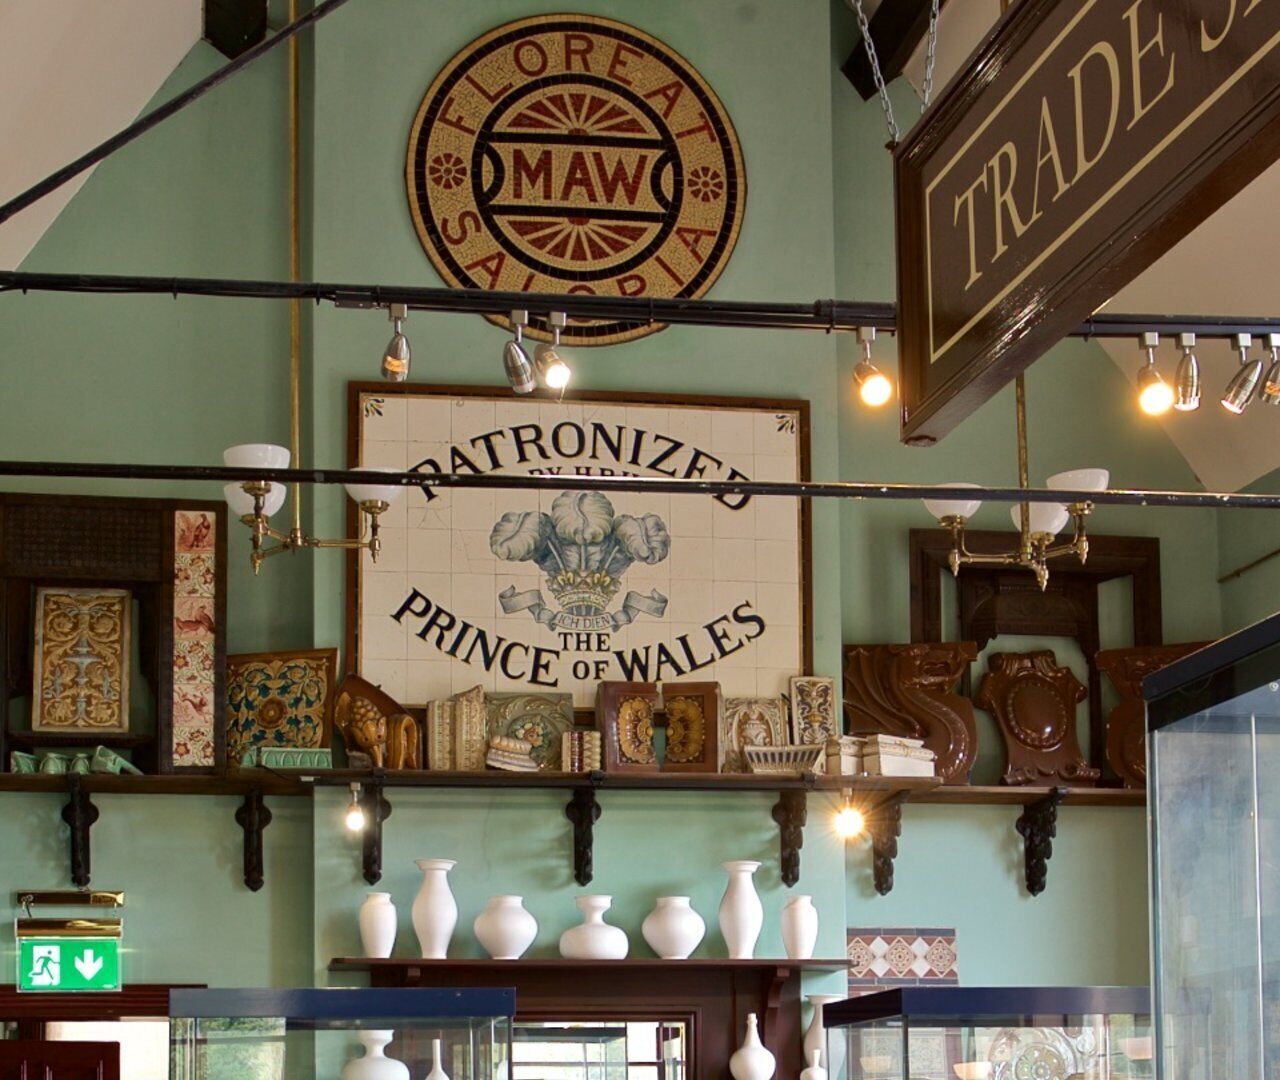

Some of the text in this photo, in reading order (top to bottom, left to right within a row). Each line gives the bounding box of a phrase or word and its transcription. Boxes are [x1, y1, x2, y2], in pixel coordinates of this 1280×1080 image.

[437, 33, 718, 144] FLOREAT
[512, 148, 649, 206] MAW
[953, 0, 1176, 292] TRADE
[441, 210, 718, 300] SAPIA
[407, 421, 753, 511] PATRONIZED
[390, 587, 561, 688] PRINCE
[557, 614, 612, 629] ICH DIEN
[558, 632, 611, 652] THE
[572, 600, 767, 682] OF WALES
